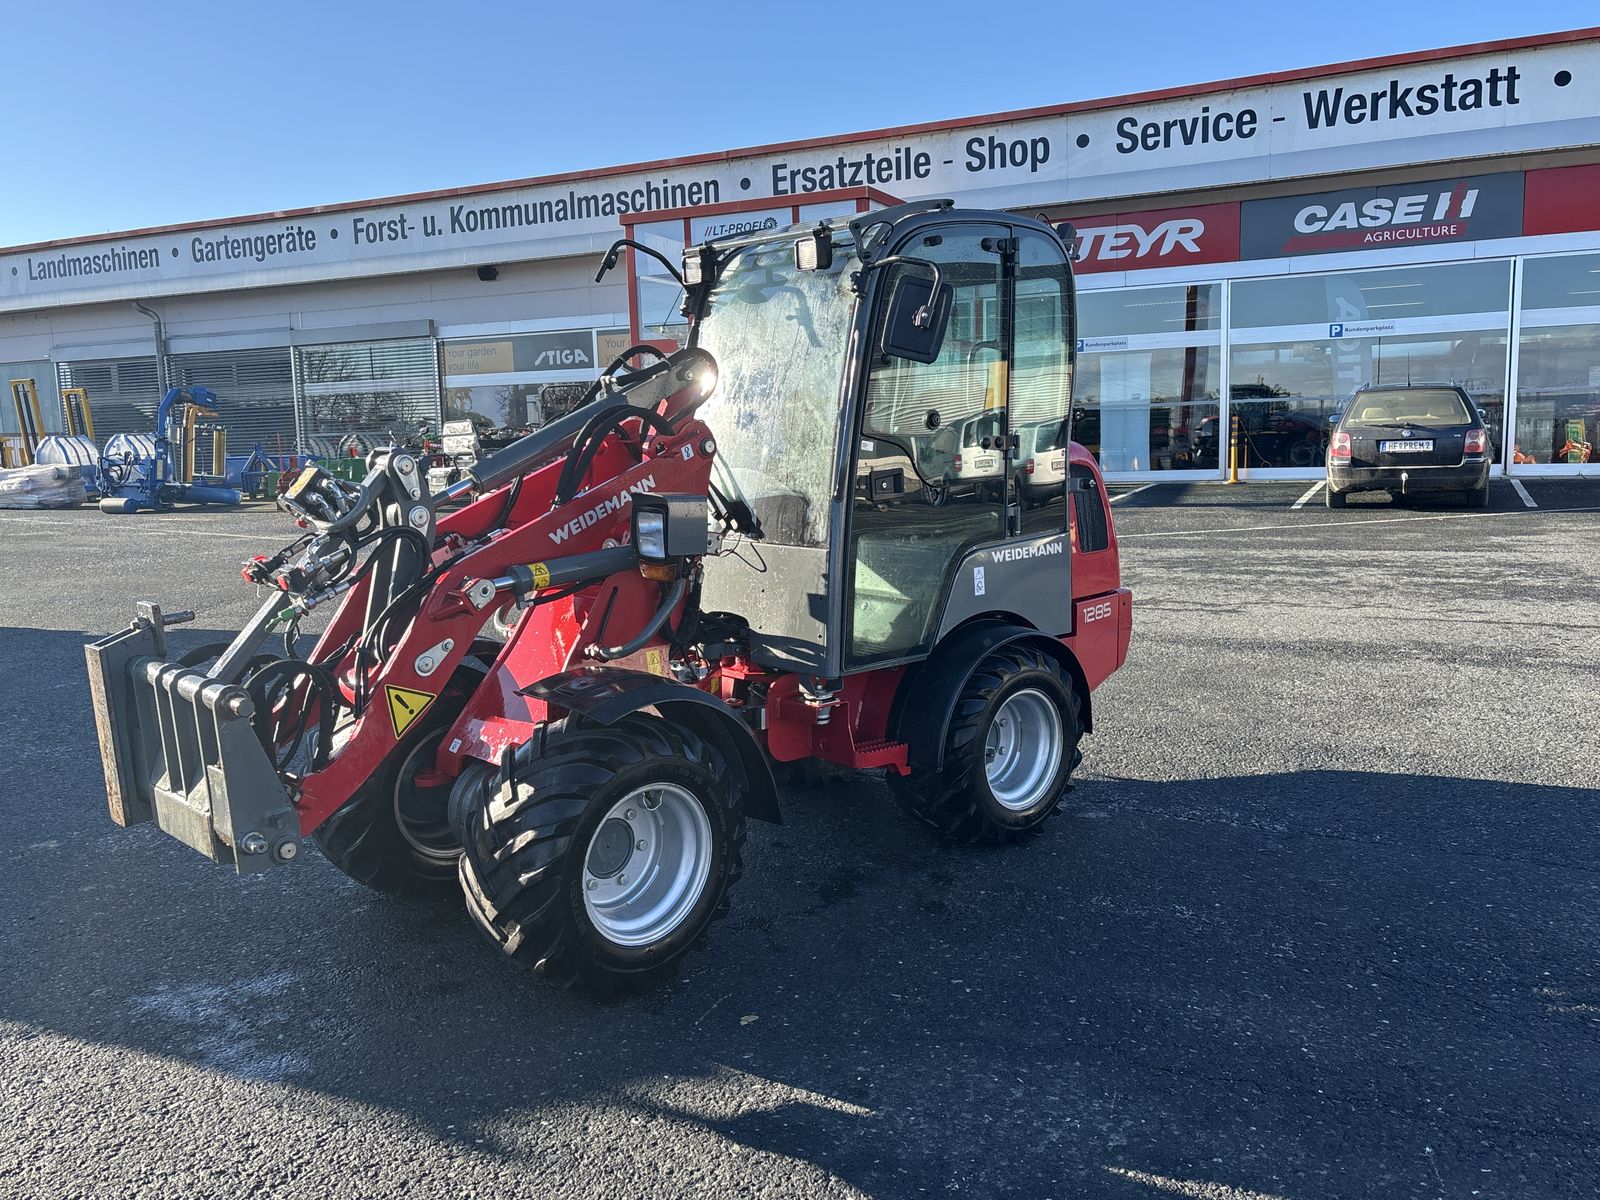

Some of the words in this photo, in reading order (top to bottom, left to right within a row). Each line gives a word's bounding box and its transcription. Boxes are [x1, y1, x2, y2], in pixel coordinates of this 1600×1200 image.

[28, 247, 160, 281] Landmaschinen
[191, 226, 317, 263] Gartengeräte
[353, 212, 415, 245] Forst-
[423, 216, 443, 237] u.
[450, 178, 720, 234] Kommunalmaschinen
[772, 146, 931, 196] Ersatzteile
[965, 135, 1051, 173] Shop
[1116, 106, 1257, 154] Service
[1303, 66, 1521, 130] Werkstatt
[1293, 194, 1428, 234] CASE
[1075, 218, 1205, 263] TEYR
[1363, 224, 1458, 243] AGRICULTURE
[1344, 324, 1395, 333] Kundenparkplatz
[446, 347, 466, 358] Your
[604, 338, 625, 349] Your
[447, 362, 466, 373] your
[467, 359, 480, 370] life
[534, 348, 589, 366] STIGA
[548, 474, 656, 545] WEIDEMANN
[991, 541, 1063, 563] WEIDEMANN
[1083, 602, 1112, 624] 1285
